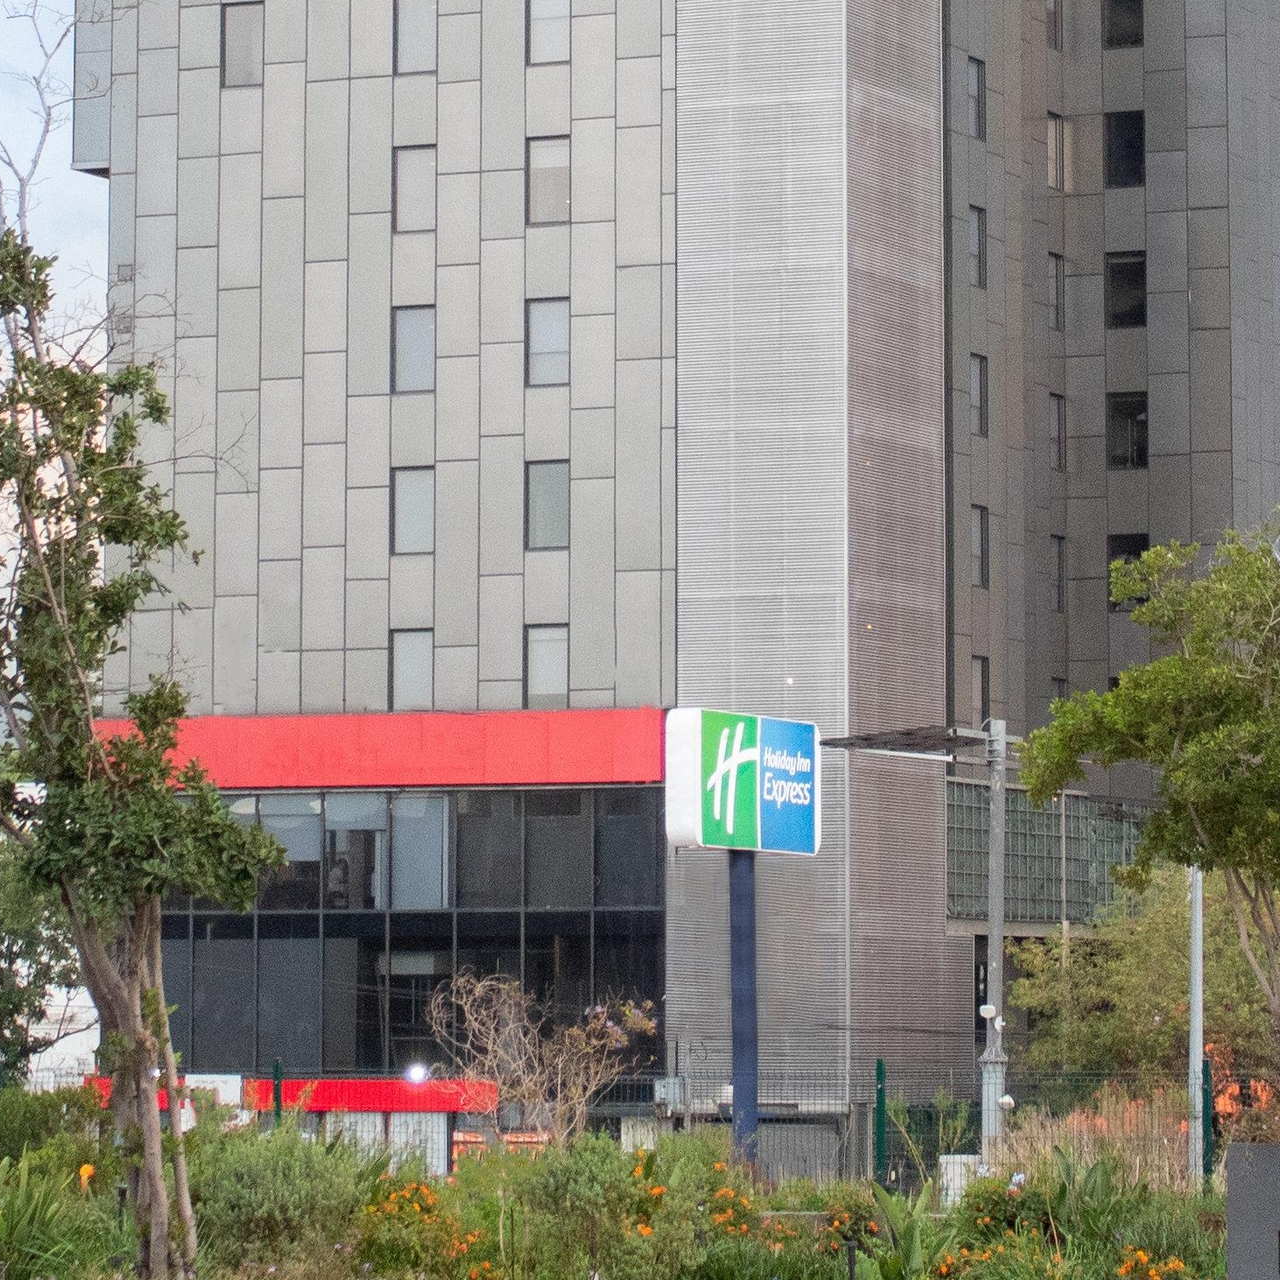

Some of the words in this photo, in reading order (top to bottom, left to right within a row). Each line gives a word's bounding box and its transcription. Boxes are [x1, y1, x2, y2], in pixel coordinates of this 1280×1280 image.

[763, 746, 797, 776] Holiday
[797, 751, 811, 773] Inn
[763, 771, 810, 809] Express
